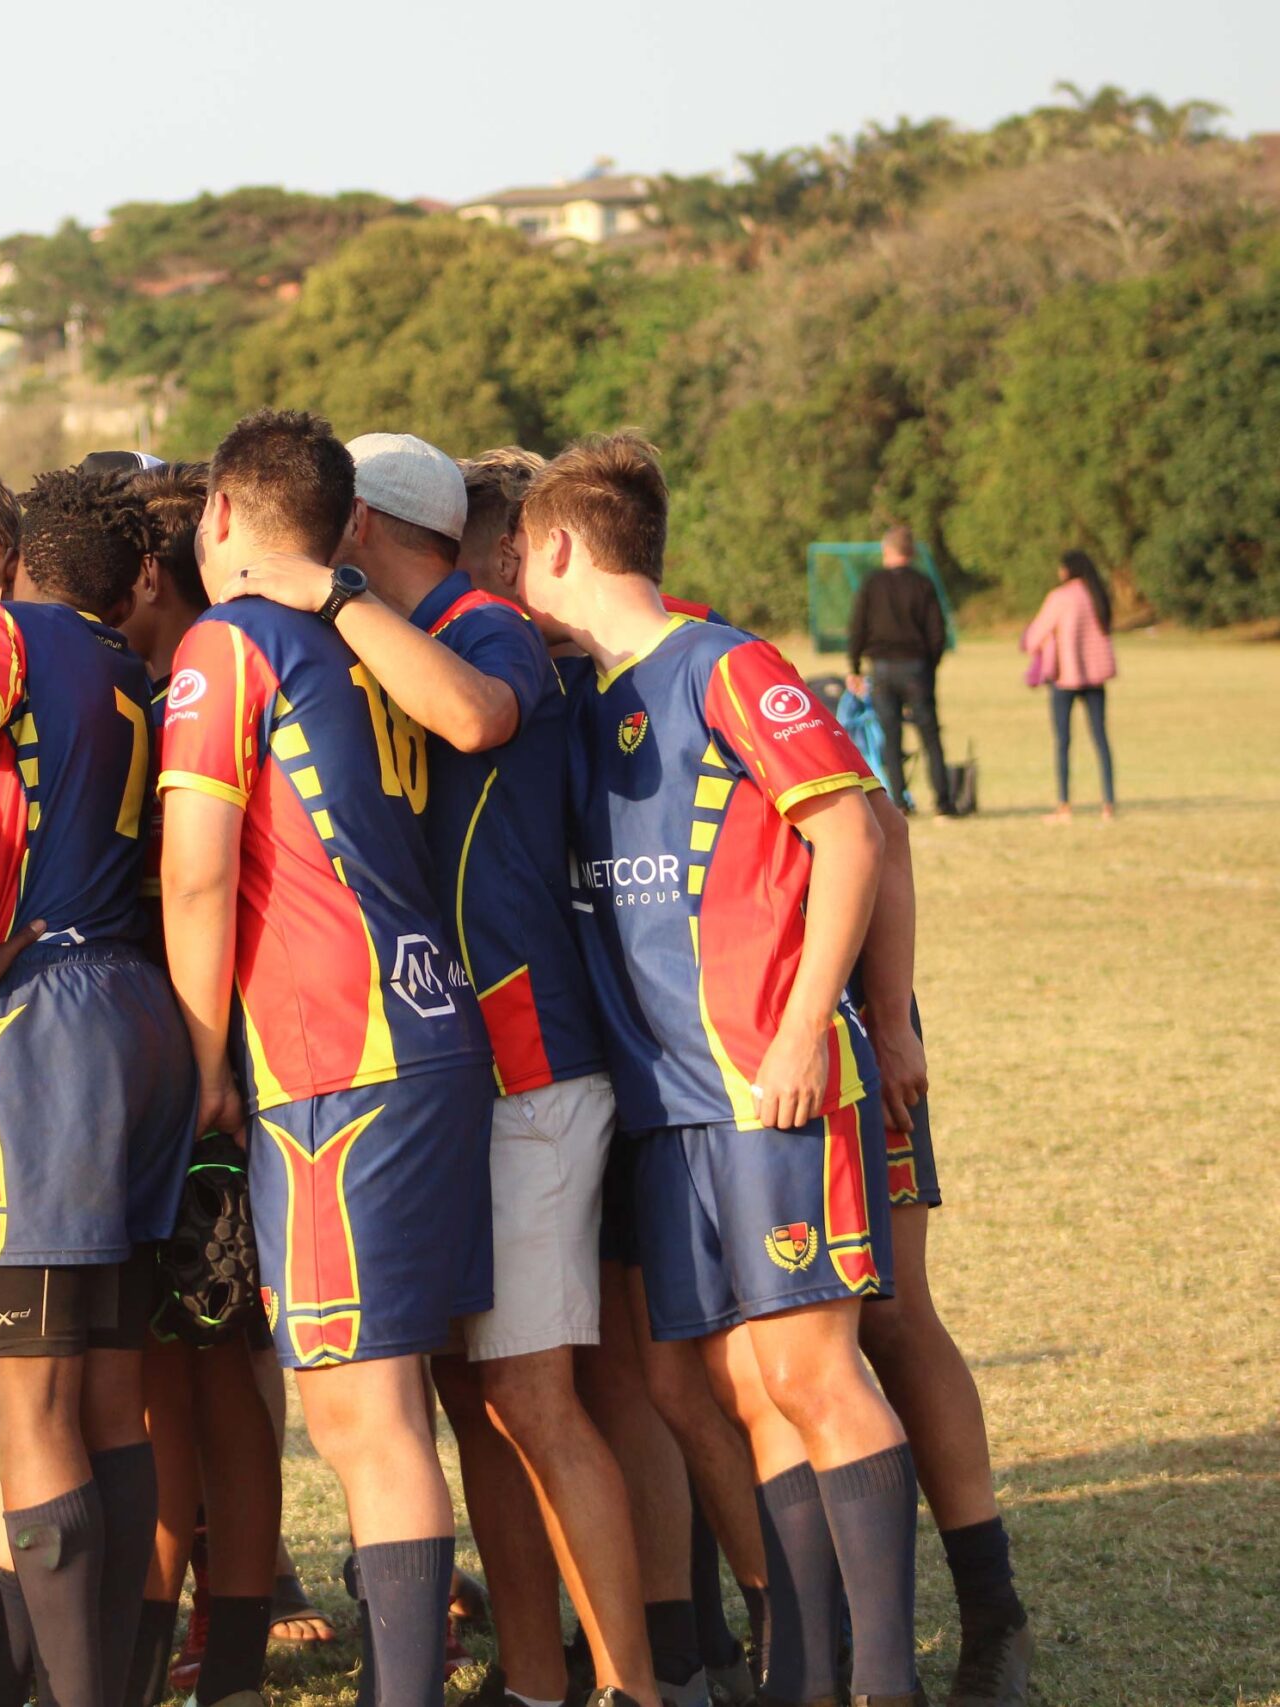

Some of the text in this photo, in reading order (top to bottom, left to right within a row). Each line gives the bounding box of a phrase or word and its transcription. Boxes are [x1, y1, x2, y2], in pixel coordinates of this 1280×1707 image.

[773, 719, 825, 742] optimum
[581, 854, 680, 887] METCOR
[615, 890, 681, 907] GROUP
